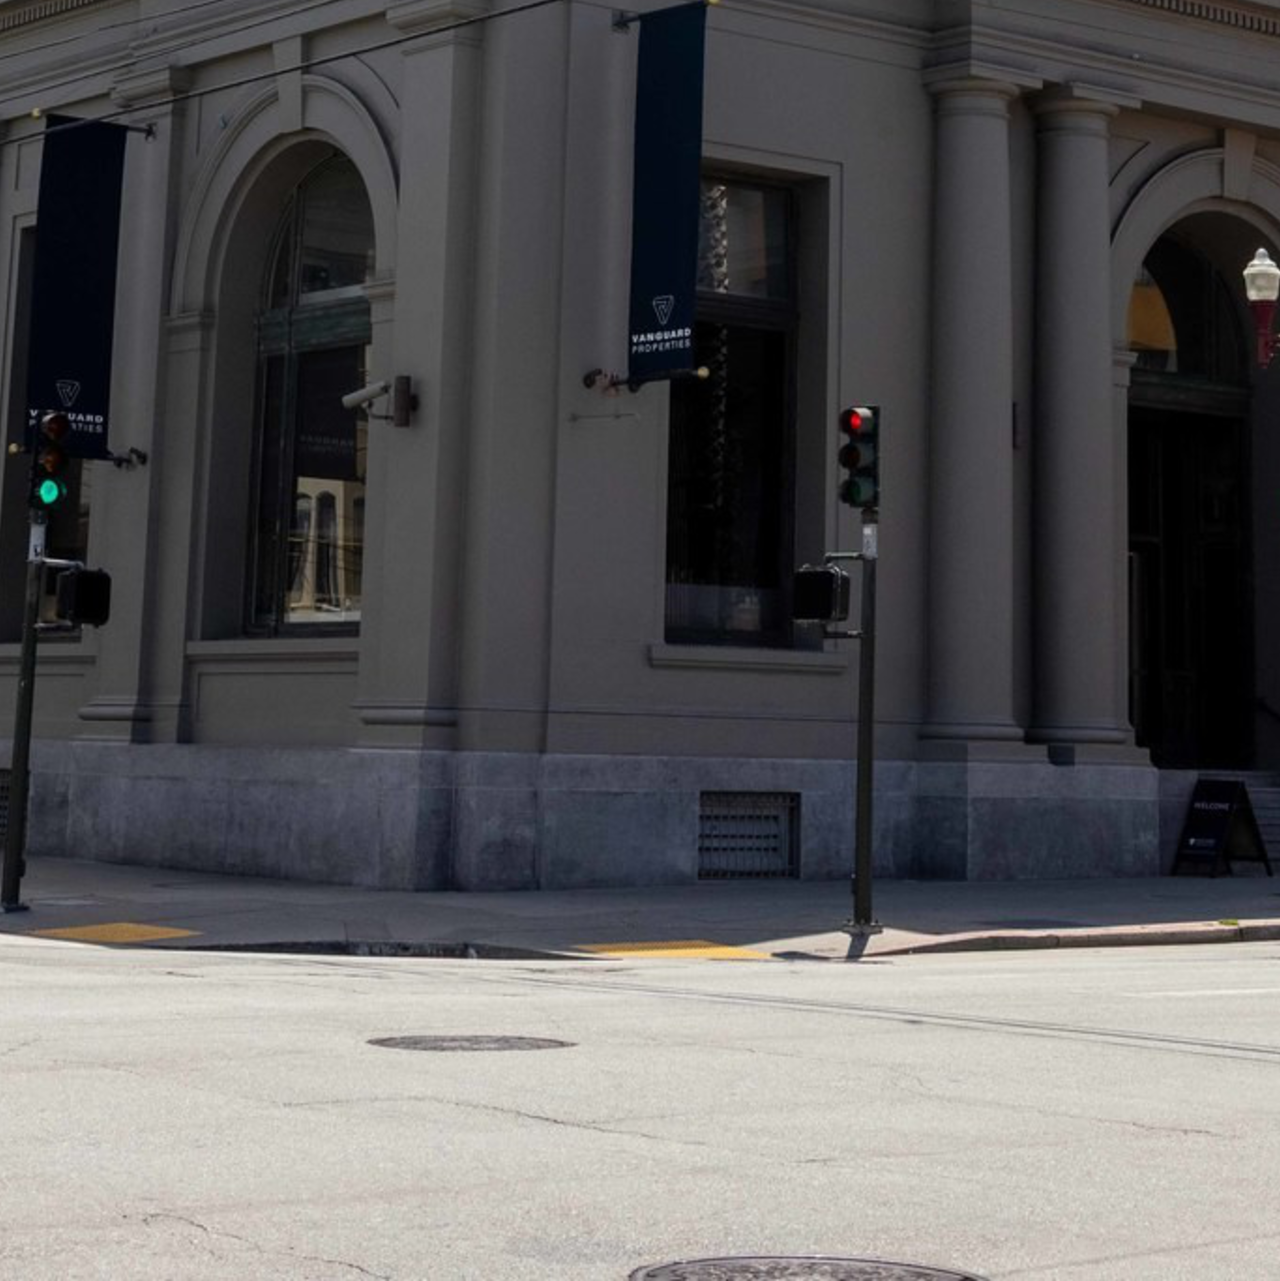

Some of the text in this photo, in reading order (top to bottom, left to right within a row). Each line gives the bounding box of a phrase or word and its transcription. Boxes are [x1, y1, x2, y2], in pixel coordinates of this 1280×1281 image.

[632, 328, 691, 343] VANGUARD
[632, 339, 690, 354] PROPERTIES
[30, 409, 103, 423] VUARD
[29, 419, 102, 433] PRTIES
[1194, 802, 1230, 811] WELCOME
